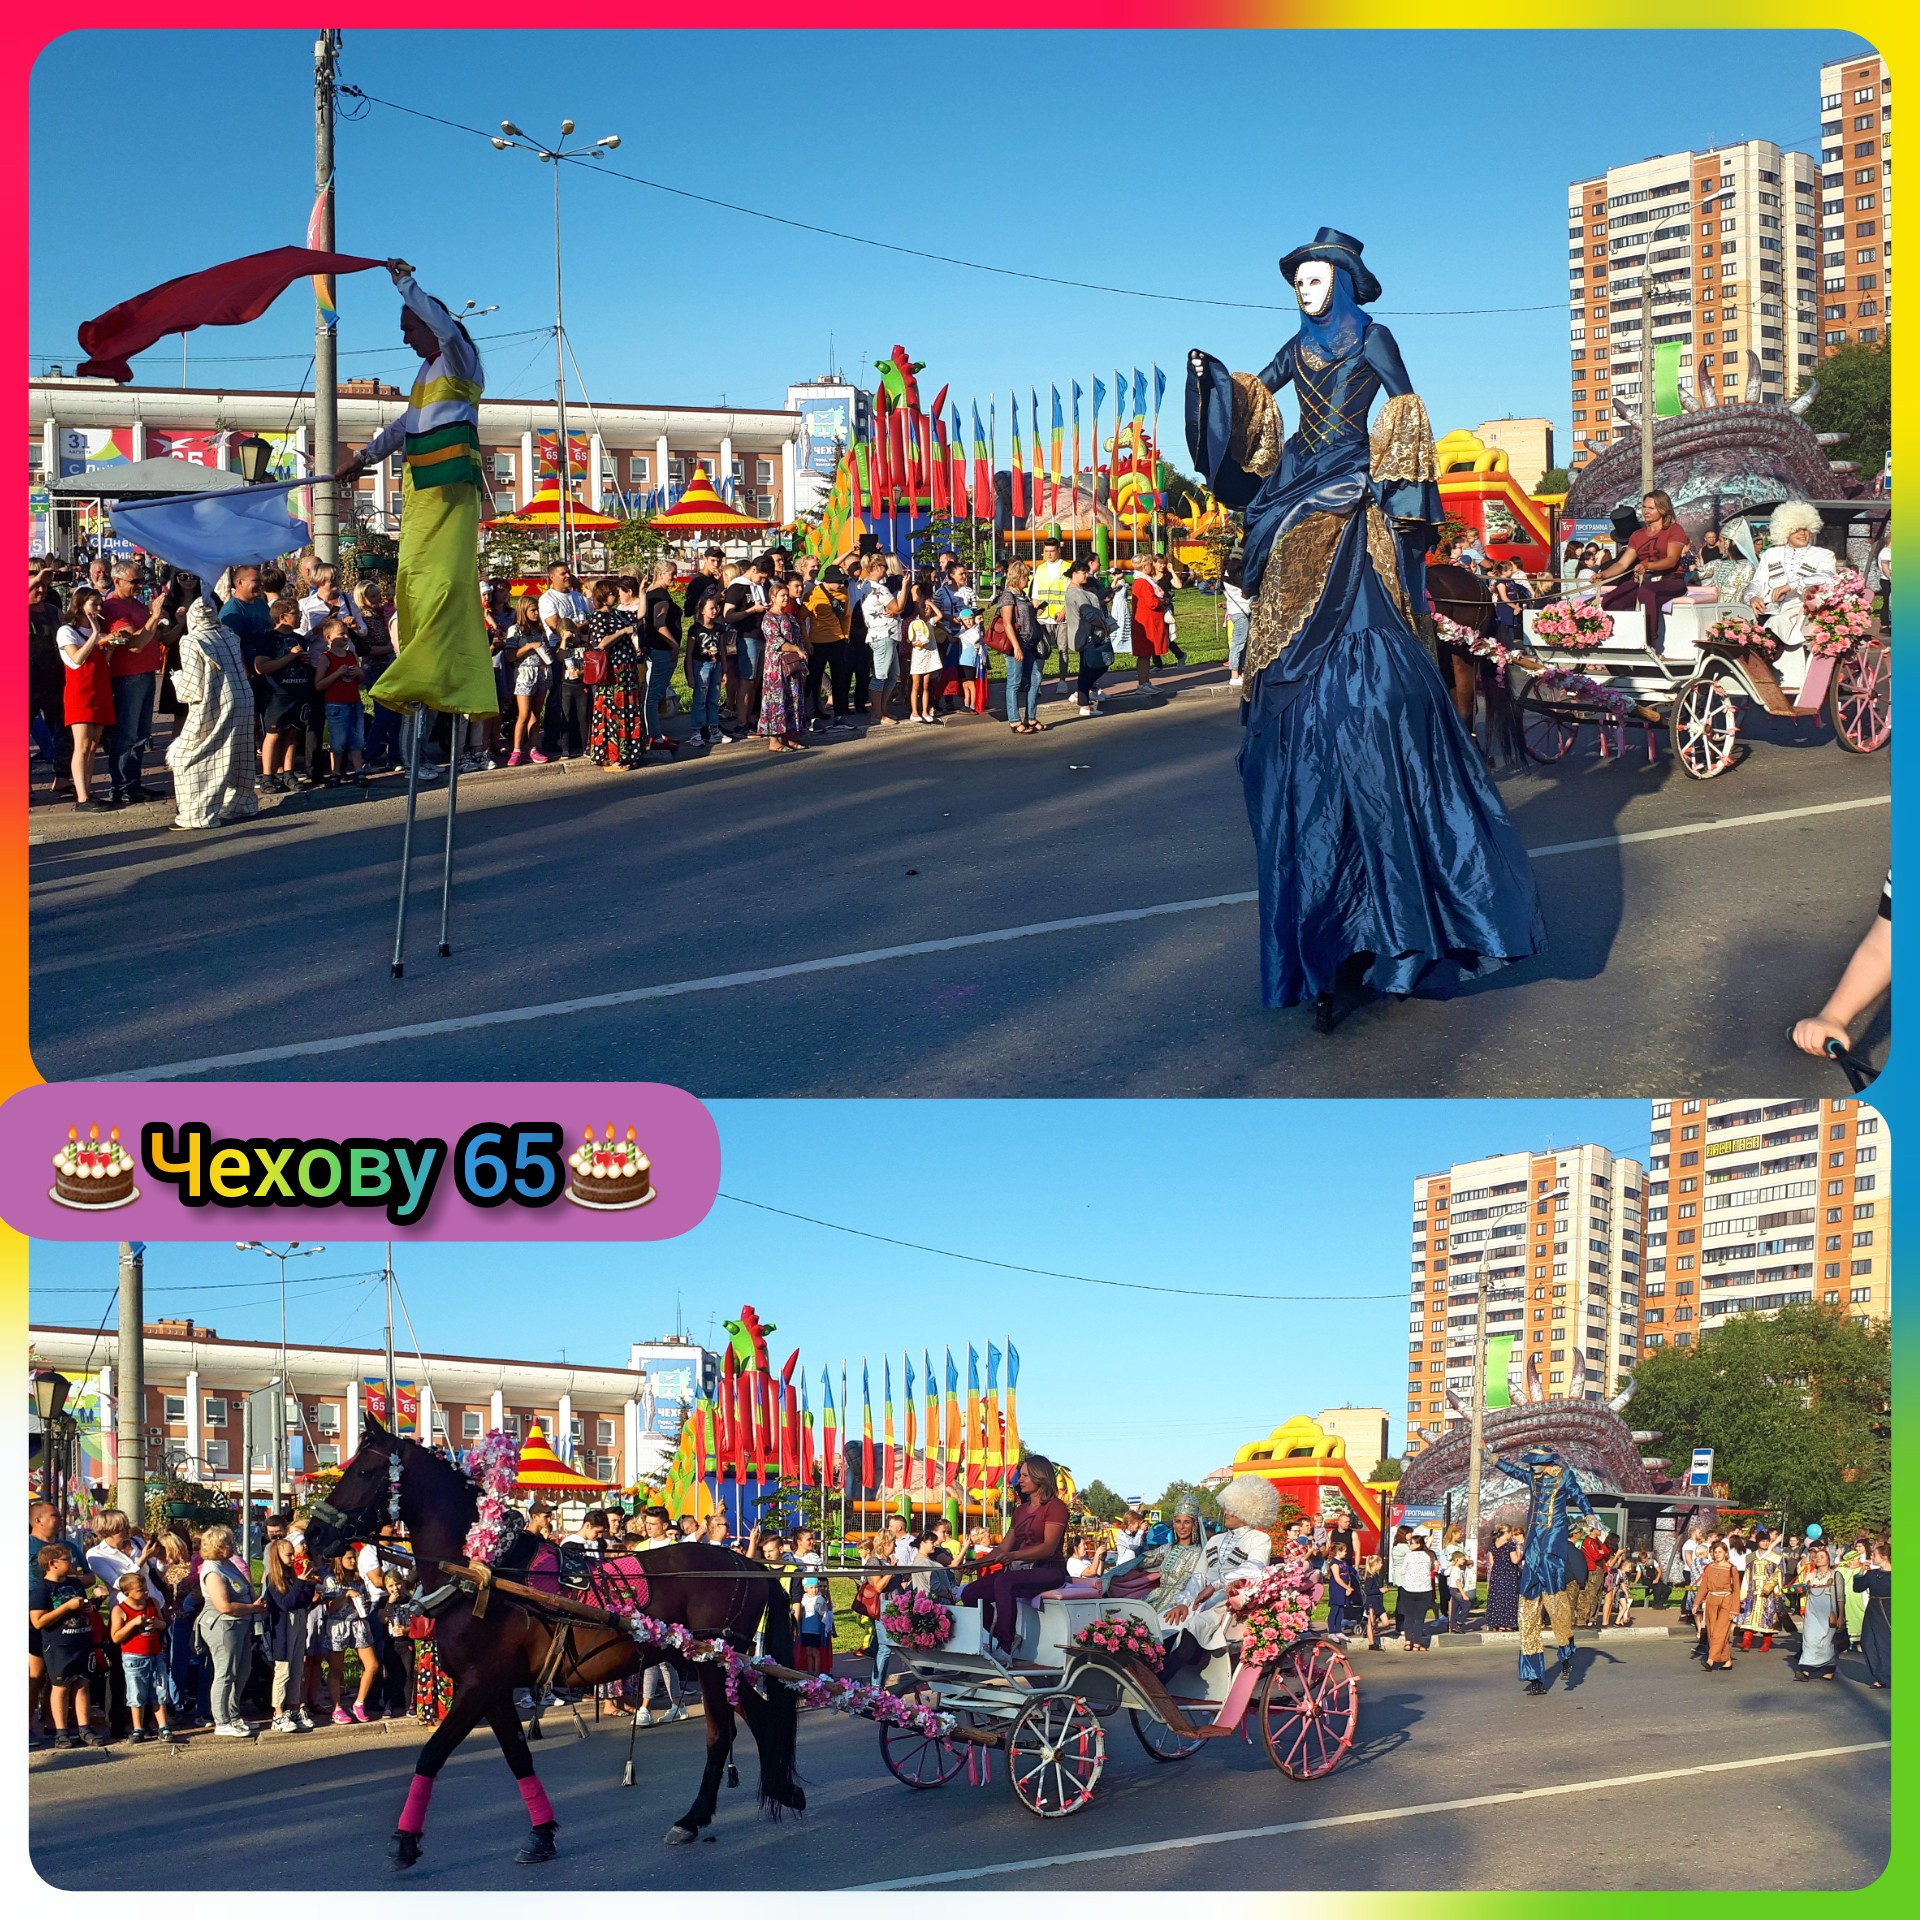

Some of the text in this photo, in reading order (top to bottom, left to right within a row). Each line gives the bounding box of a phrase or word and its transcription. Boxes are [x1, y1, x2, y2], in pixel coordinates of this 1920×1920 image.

[68, 434, 90, 449] 31
[546, 451, 558, 460] 65
[575, 452, 587, 461] 65
[373, 1402, 385, 1411] 65
[403, 1404, 416, 1413] 65
